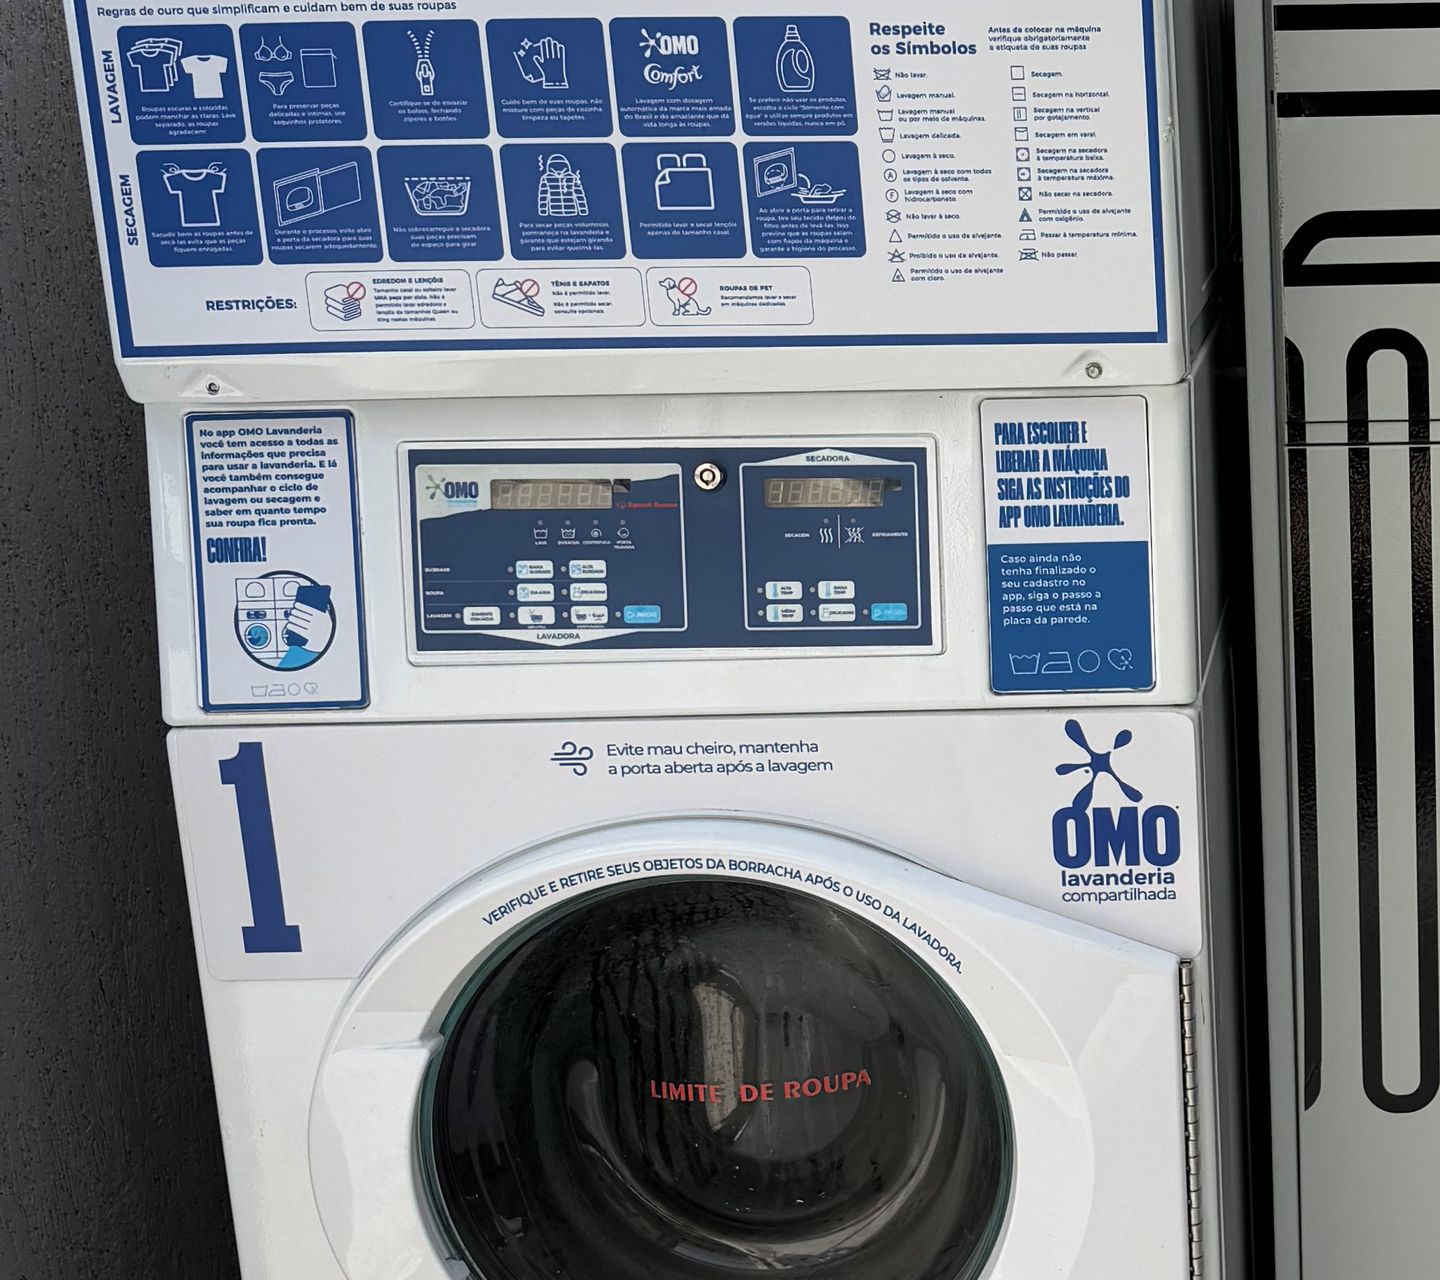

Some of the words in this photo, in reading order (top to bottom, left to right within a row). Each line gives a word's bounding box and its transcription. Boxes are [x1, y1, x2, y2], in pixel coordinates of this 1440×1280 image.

[96, 7, 137, 19] Regras
[139, 5, 154, 16] de
[157, 7, 184, 16] ouro
[186, 6, 210, 17] que
[212, 3, 280, 17] simplificam
[282, 5, 290, 13] e
[293, 1, 338, 13] cuidam
[340, 1, 368, 12] bem
[370, 0, 386, 11] de
[388, 2, 415, 11] suas
[417, 1, 457, 12] roupas
[869, 21, 946, 43] Respeite
[987, 26, 1011, 37] Antes
[1012, 26, 1023, 34] de
[1024, 26, 1053, 34] colocar
[1066, 25, 1102, 34] máquina
[988, 34, 1022, 44] verifique
[1023, 34, 1090, 43] obrigatoriamente
[660, 34, 699, 55] OMO
[870, 44, 891, 56] os
[895, 36, 977, 55] Símbolos
[995, 43, 1028, 53] etiqueta
[1029, 43, 1040, 51] de
[643, 63, 703, 91] Comfort
[101, 50, 123, 124] LAVAGEM
[118, 174, 139, 246] SECAGEM
[205, 295, 298, 313] RESTRIÇÕES:
[199, 429, 214, 438] No
[215, 429, 236, 439] app
[237, 427, 264, 437] OMO
[265, 425, 323, 436] Lavanderia
[994, 422, 1026, 446] PARA
[1026, 420, 1080, 448] ESCOLHER
[1080, 420, 1088, 444] E
[199, 439, 225, 449] você
[226, 439, 248, 448] tem
[249, 439, 285, 448] acesso
[295, 437, 325, 446] todas
[200, 450, 265, 461] informações
[266, 451, 287, 460] que
[288, 448, 327, 460] precisa
[805, 455, 850, 463] SECADORA
[995, 449, 1041, 473] LIBERAR
[1042, 449, 1051, 473] A
[1052, 446, 1109, 474] MÁQUINA
[201, 464, 225, 474] para
[226, 463, 250, 471] usar
[259, 459, 317, 470] lavanderia.
[318, 460, 326, 469] E
[327, 459, 338, 468] lá
[202, 473, 227, 483] você
[228, 472, 273, 482] também
[274, 472, 325, 482] consegue
[203, 484, 268, 495] acompanhar
[269, 485, 277, 493] o
[278, 483, 303, 492] ciclo
[305, 482, 319, 491] de
[443, 480, 480, 500] OMO
[996, 477, 1025, 501] SIGA
[1026, 476, 1042, 501] AS
[1043, 474, 1113, 502] INSTRUÇÕES
[1114, 475, 1130, 499] DO
[203, 496, 248, 507] lavagem
[265, 495, 312, 505] secagem
[313, 495, 321, 503] e
[204, 507, 233, 517] saber
[235, 508, 252, 516] em
[254, 507, 291, 517] quanto
[292, 506, 327, 516] tempo
[998, 505, 1022, 529] APP
[1023, 504, 1052, 528] OMO
[1052, 501, 1125, 528] LAVANDERIA.
[205, 520, 224, 528] sua
[226, 519, 256, 529] roupa
[257, 517, 278, 527] fica
[279, 517, 317, 528] pronta.
[206, 536, 267, 564] CONFIRA!
[1000, 554, 1027, 564] Caso
[1029, 553, 1059, 563] ainda
[1061, 553, 1082, 562] não
[1001, 566, 1033, 576] tenha
[1034, 565, 1087, 575] finalizado
[1089, 566, 1097, 574] o
[1001, 581, 1021, 589] seu
[1022, 578, 1070, 588] cadastro
[1072, 579, 1086, 587] no
[1002, 593, 1026, 602] app,
[1027, 590, 1050, 602] siga
[1052, 592, 1059, 600] o
[1061, 591, 1093, 601] passo
[1002, 605, 1034, 615] passo
[1035, 604, 1057, 614] que
[1058, 602, 1082, 612] está
[1084, 603, 1098, 611] na
[1003, 616, 1032, 627] placa
[1033, 615, 1048, 625] da
[1050, 614, 1091, 626] parede.
[536, 632, 581, 640] LAVADORA
[606, 742, 645, 757] Evite
[647, 745, 683, 756] mau
[685, 741, 737, 756] cheiro,
[739, 739, 819, 754] mantenha
[608, 765, 618, 776] a
[620, 762, 662, 777] porta
[664, 760, 714, 774] aberta
[716, 759, 754, 776] após
[755, 762, 765, 773] a
[768, 759, 833, 775] lavagem
[1052, 803, 1181, 868] OMO
[218, 741, 301, 954] 1
[1061, 868, 1175, 887] lavanderia
[1061, 886, 1177, 905] compartilhada
[482, 884, 549, 926] VERIFIQUE
[548, 880, 560, 893] E
[559, 866, 606, 890] RETIRE
[606, 860, 641, 878] SEUS
[642, 857, 704, 872] OBJETOS
[706, 857, 726, 871] DA
[728, 859, 803, 882] BORRACHA
[804, 872, 841, 893] APÓS
[842, 885, 854, 897] O
[855, 892, 882, 911] USO
[882, 904, 901, 923] DA
[901, 916, 963, 975] LAVADORA.
[649, 1078, 723, 1104] LIMITE
[738, 1081, 775, 1103] DE
[783, 1067, 873, 1100] ROUPA
